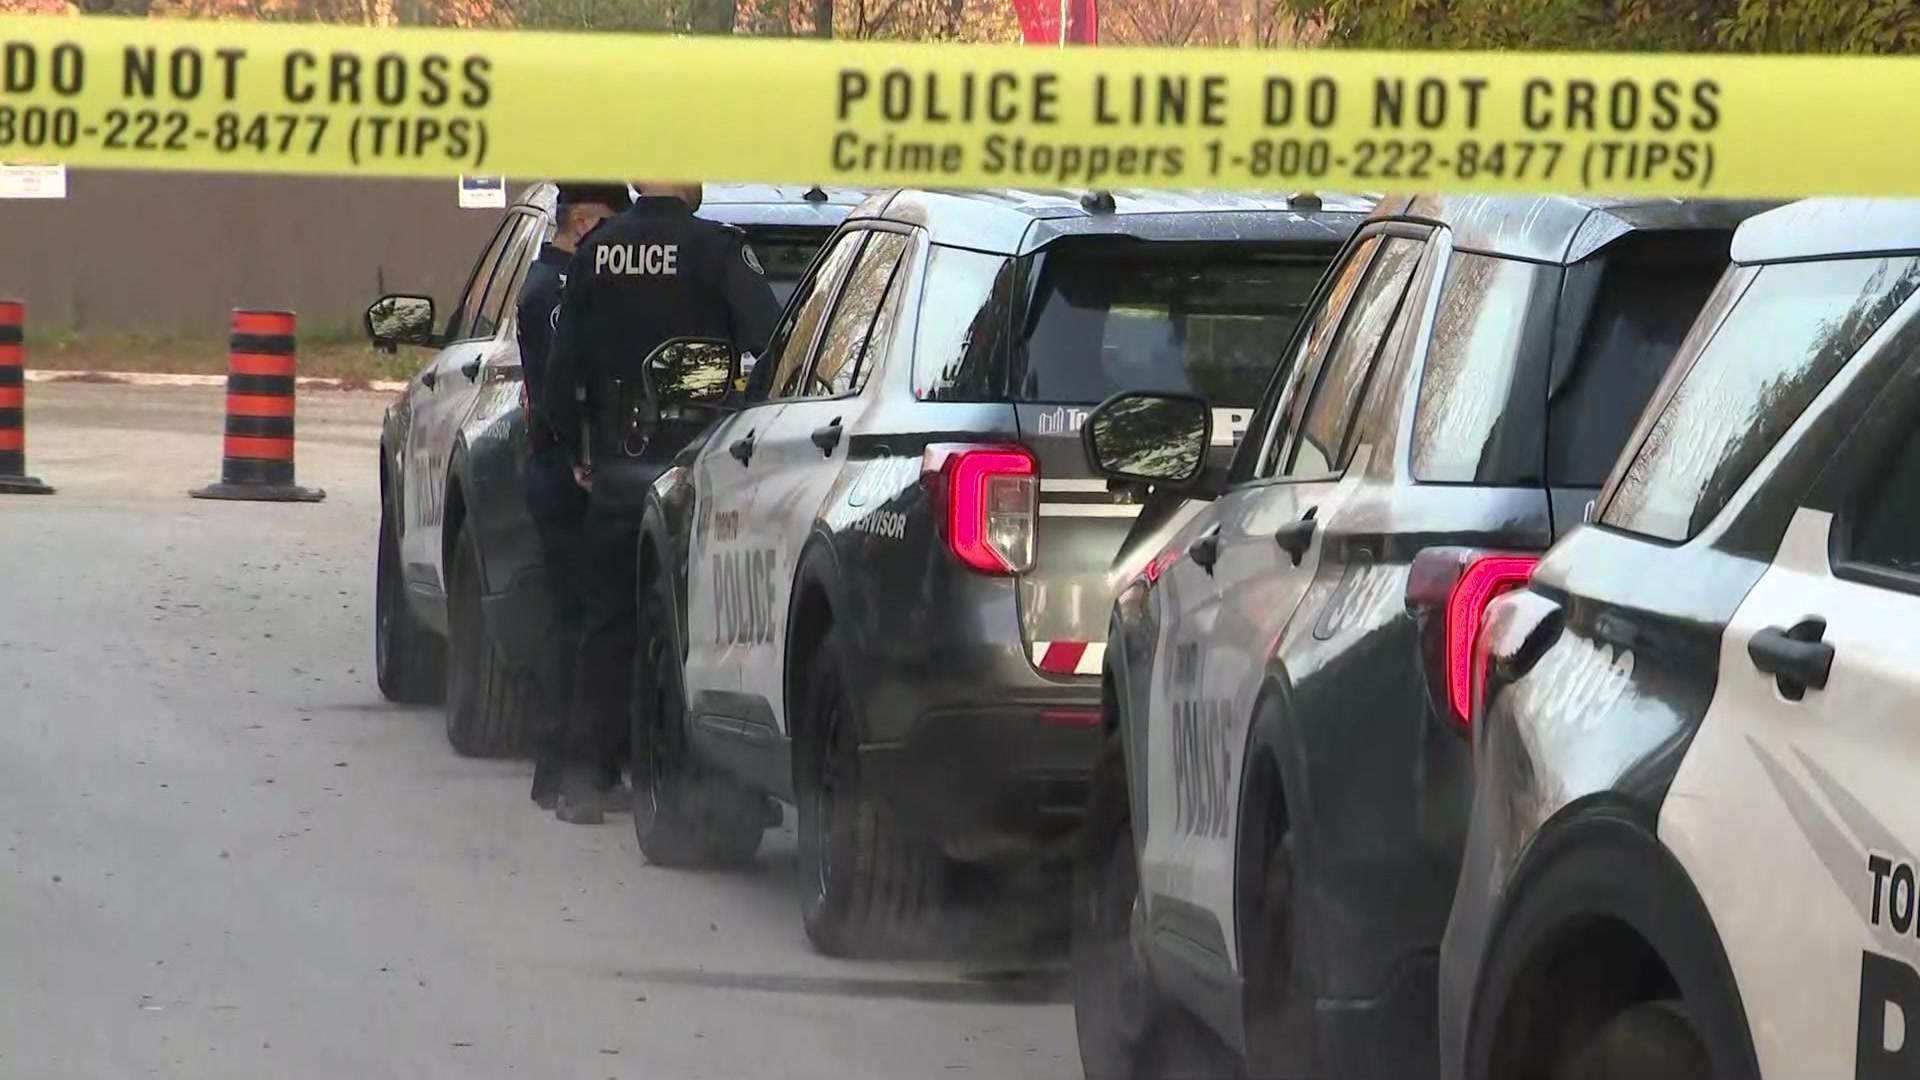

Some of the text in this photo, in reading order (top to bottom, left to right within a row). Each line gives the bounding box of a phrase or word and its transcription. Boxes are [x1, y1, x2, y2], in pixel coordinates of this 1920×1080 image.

[5, 41, 492, 107] DO NOT CROSS
[837, 69, 1721, 132] POLICE LINE DO NOT CROSS
[350, 117, 487, 166] (TIPS)
[832, 130, 1715, 187] Crime Stoppers 1-800-222-8477 (TIPS)
[595, 244, 678, 274] POLICE
[713, 549, 776, 645] POLICE
[1868, 854, 1920, 938] TO
